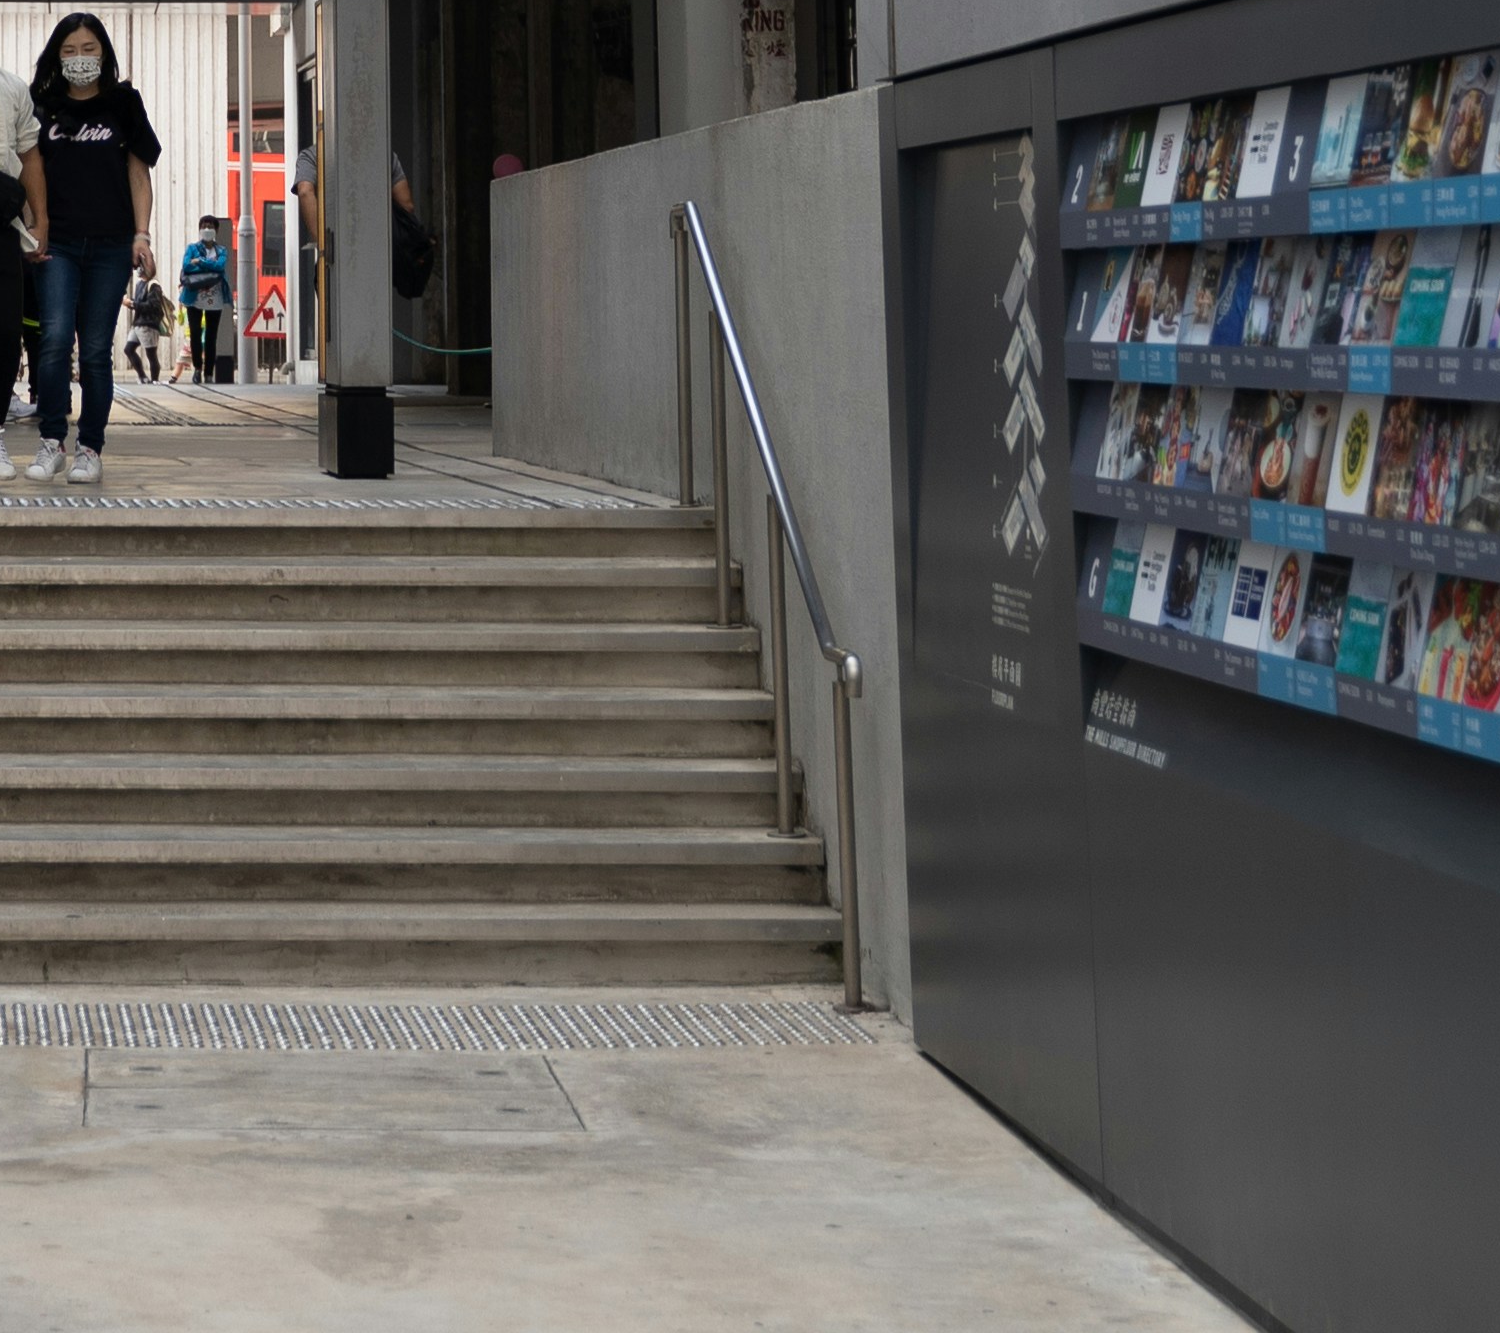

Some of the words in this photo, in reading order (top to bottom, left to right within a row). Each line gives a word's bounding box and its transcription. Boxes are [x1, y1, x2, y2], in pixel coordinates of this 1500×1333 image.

[48, 123, 112, 142] Clvin
[1289, 136, 1304, 182] 3
[1071, 164, 1084, 204] 2
[1076, 290, 1088, 332] 1
[1088, 557, 1100, 599] G
[1085, 724, 1096, 743] THE
[1094, 728, 1111, 749] MILLS
[1136, 743, 1166, 769] DIRECTORY
